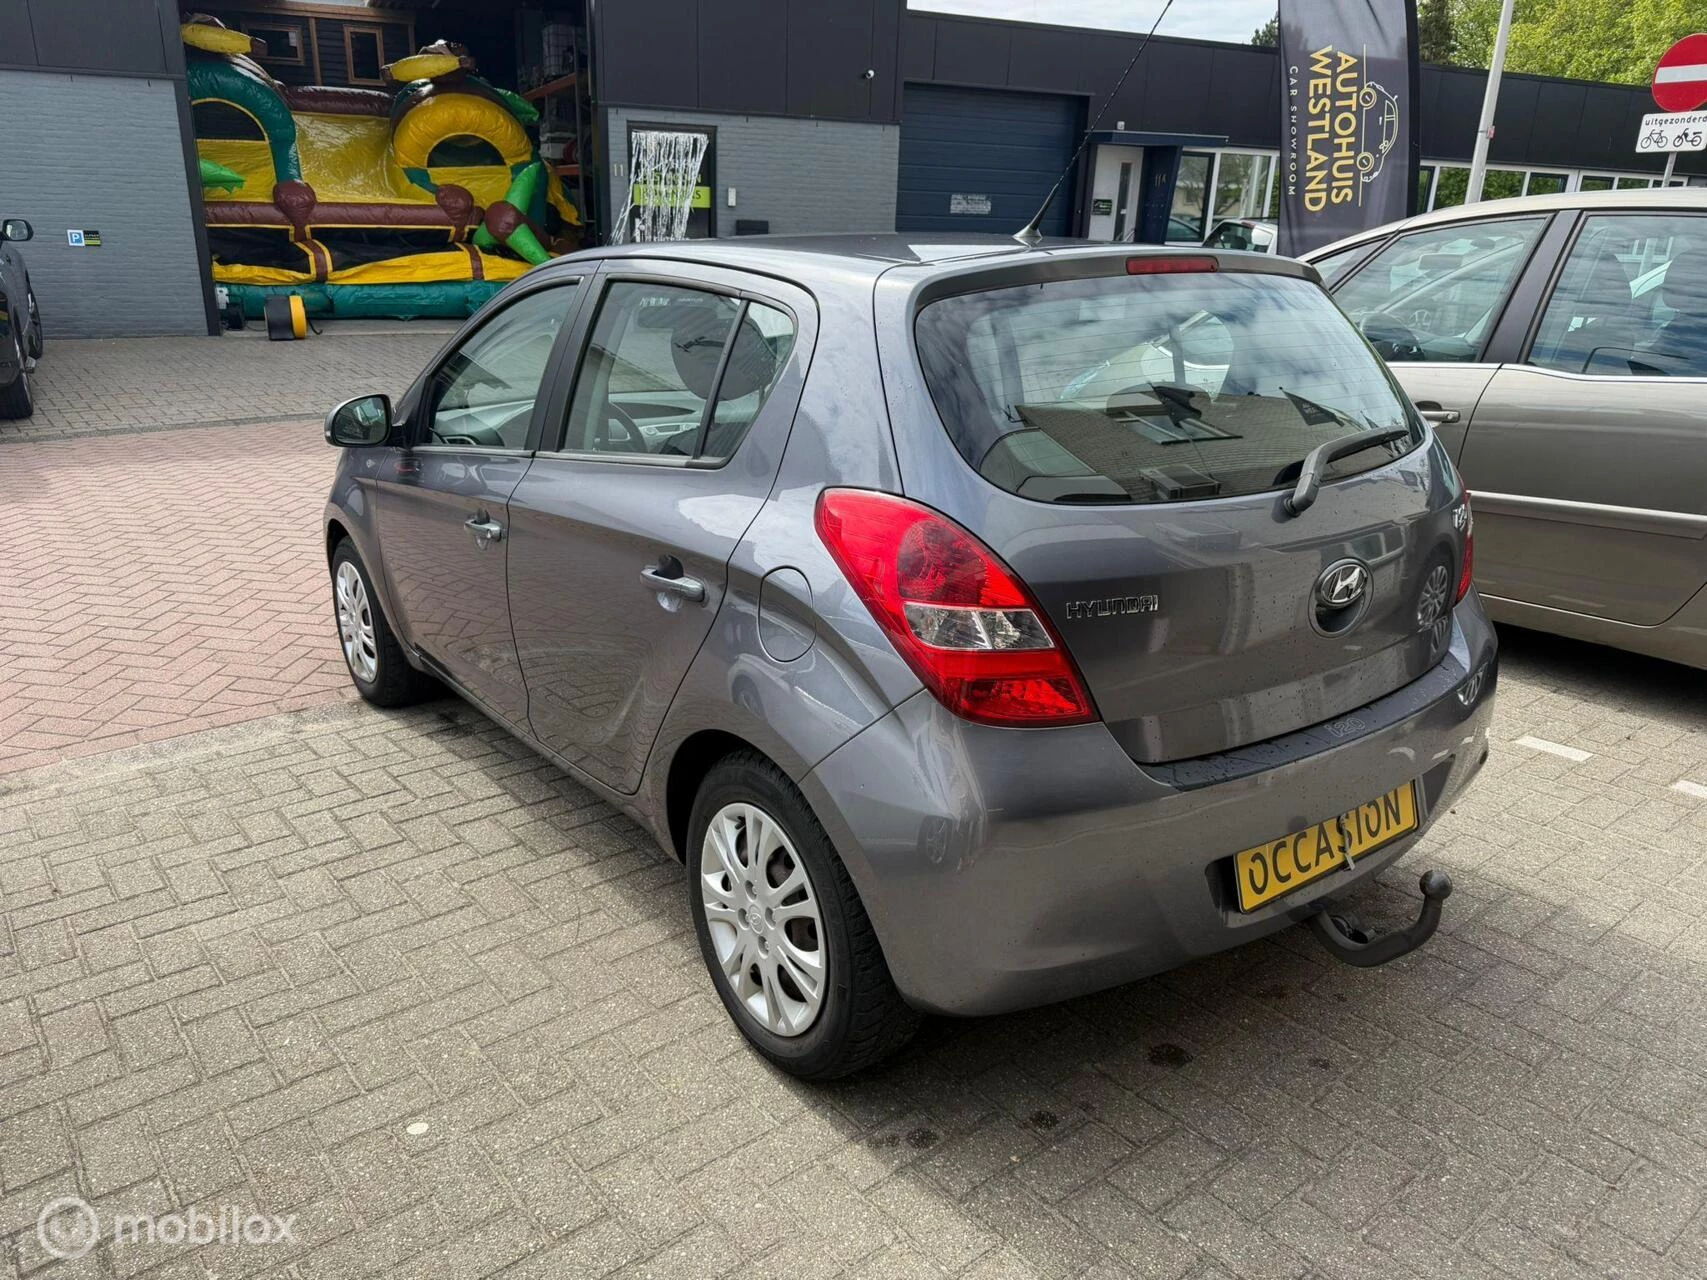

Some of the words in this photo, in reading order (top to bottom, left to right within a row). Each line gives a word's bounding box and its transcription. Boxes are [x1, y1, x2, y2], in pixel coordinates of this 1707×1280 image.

[1289, 66, 1298, 96] CAR
[1304, 44, 1333, 212] WESTLAND
[1331, 51, 1358, 204] AUTOHUIS
[1288, 105, 1298, 195] SHOWROOM
[613, 163, 624, 177] 11
[71, 233, 80, 243] P
[1065, 594, 1159, 619] HYUNDAI
[1323, 717, 1366, 738] i20
[1248, 788, 1402, 895] OCCASION
